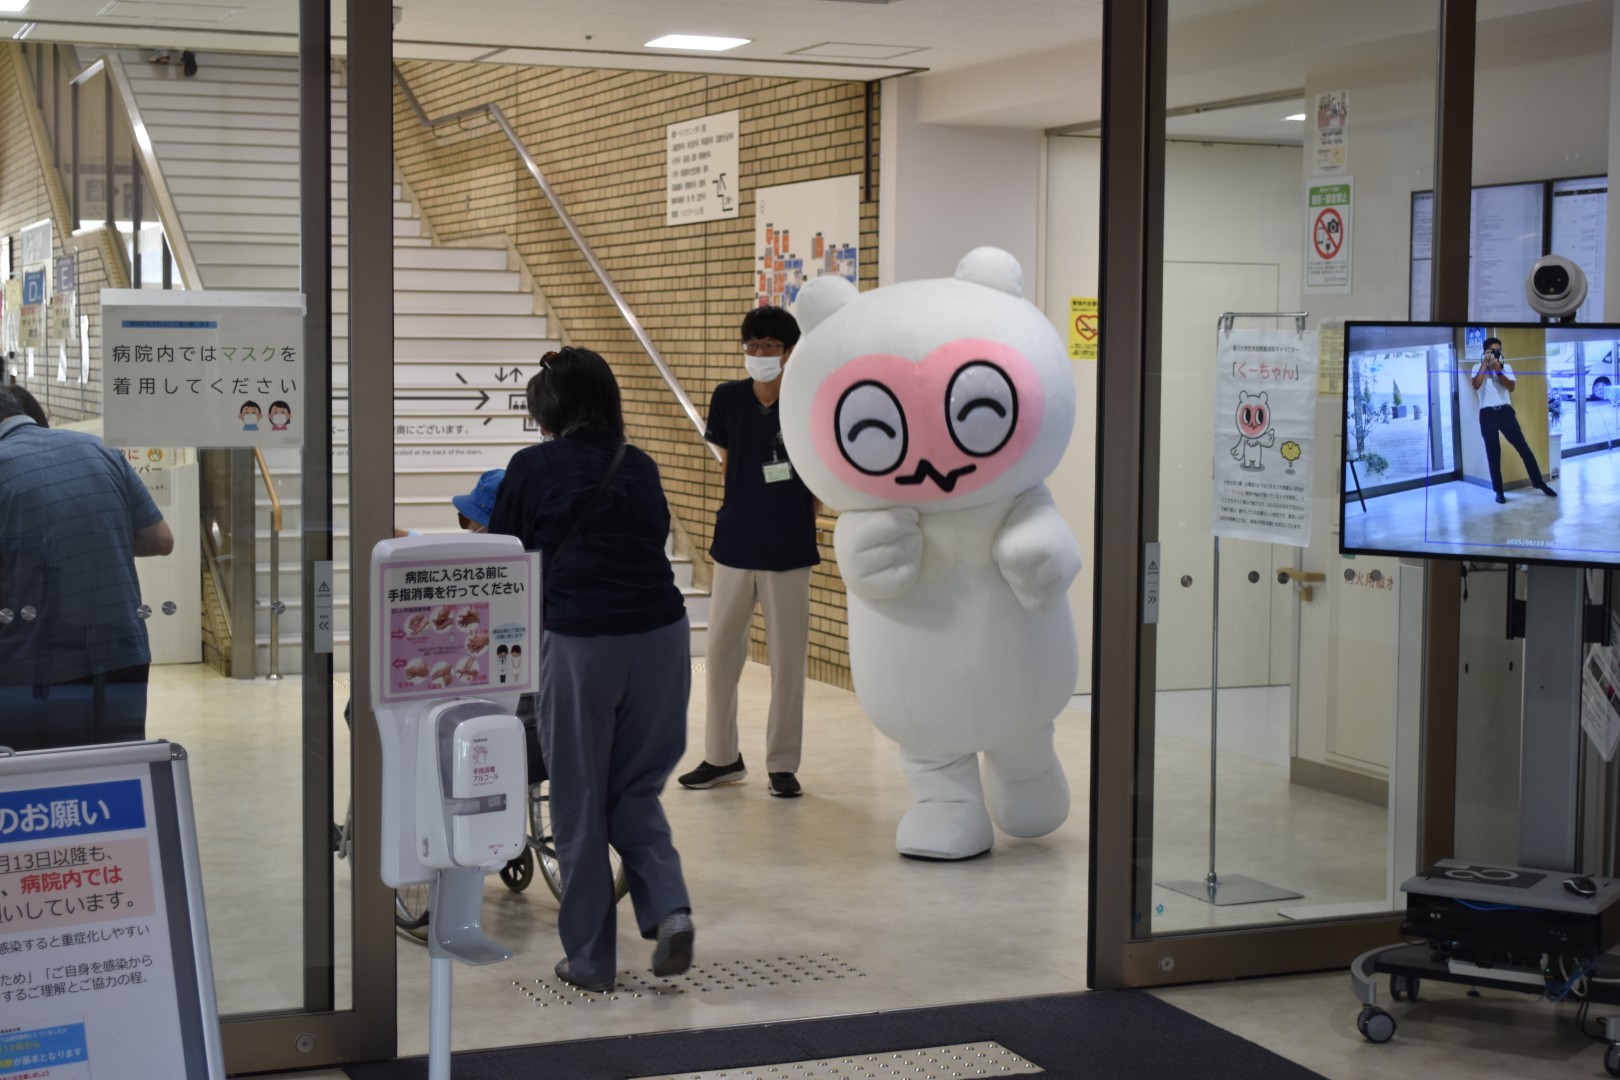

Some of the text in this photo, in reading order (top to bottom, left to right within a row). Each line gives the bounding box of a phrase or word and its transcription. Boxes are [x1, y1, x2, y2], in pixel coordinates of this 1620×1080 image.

[61, 266, 69, 290] E
[28, 281, 38, 303] D
[112, 344, 296, 363] 病院内ではマスクを
[1232, 361, 1299, 381] 「くーちゃん」
[112, 377, 297, 395] 着用してください
[394, 424, 469, 436] 奥にございます。
[134, 464, 162, 474] バー
[405, 566, 508, 585] 病院に入られる前に
[388, 582, 525, 603] 手指消毒を行ってください
[473, 774, 499, 782] アルコール
[0, 799, 111, 835] のお願い
[0, 845, 112, 873] 月13日以降も、
[0, 890, 134, 921] いしています。
[0, 924, 150, 955] 感染すると重症化しやすい
